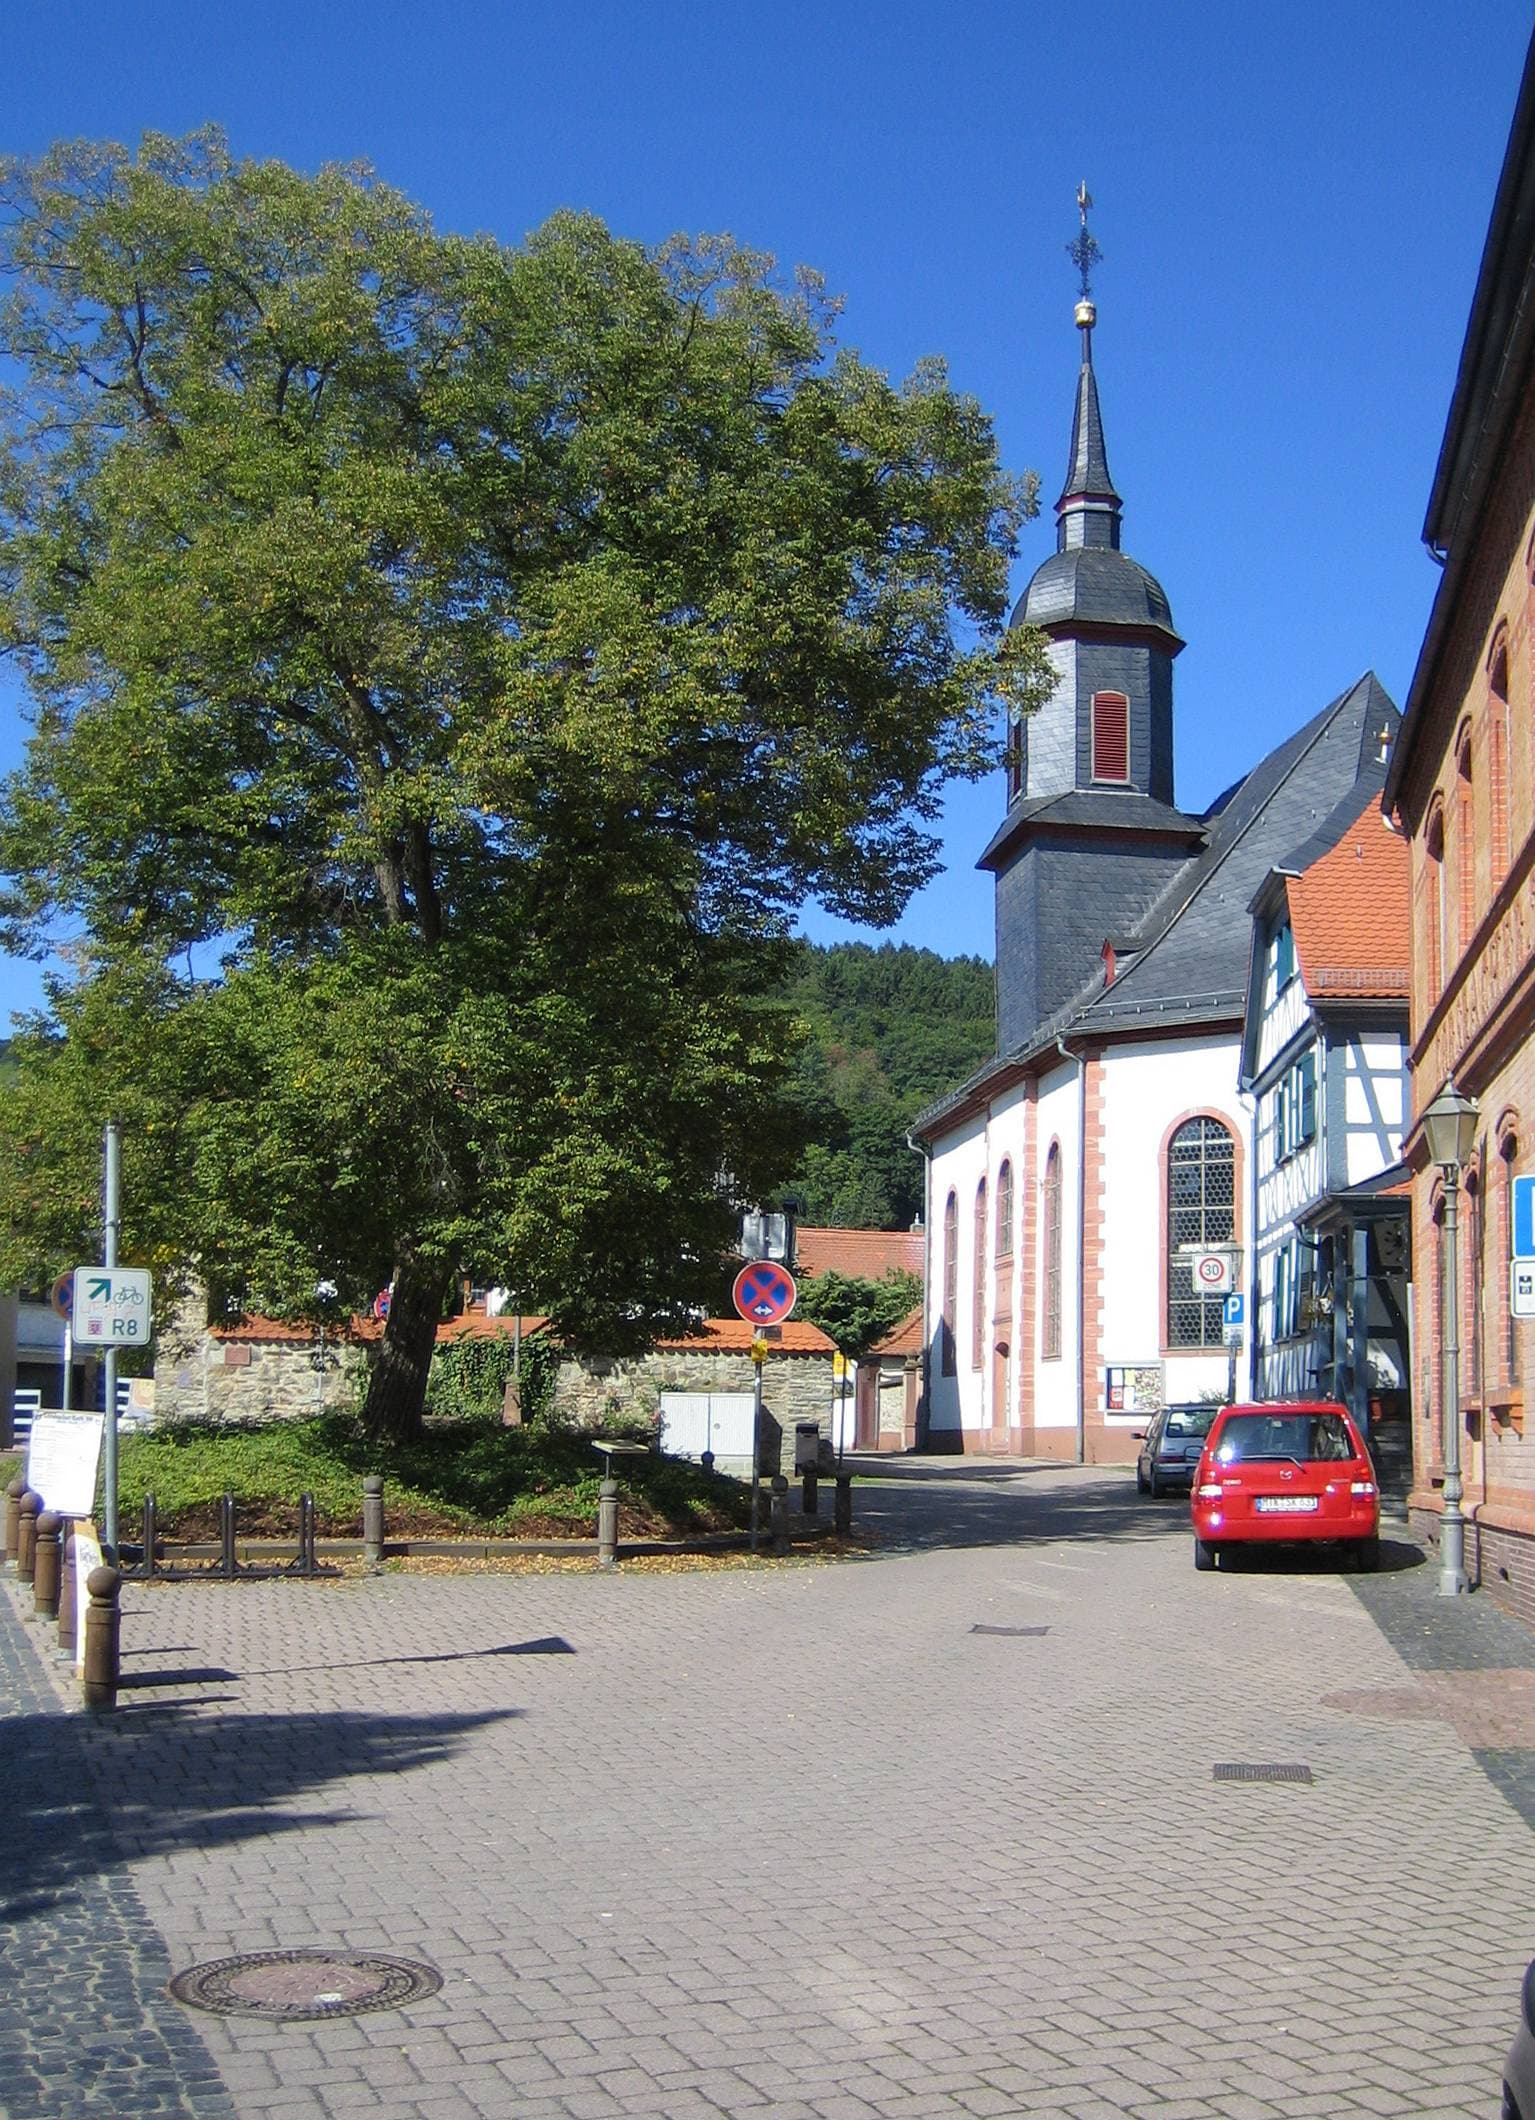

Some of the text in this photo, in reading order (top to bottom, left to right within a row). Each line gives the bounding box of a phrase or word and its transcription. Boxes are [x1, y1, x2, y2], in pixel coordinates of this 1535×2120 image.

[1204, 1264, 1219, 1276] 30
[1227, 1297, 1241, 1321] P
[112, 1318, 138, 1336] R8
